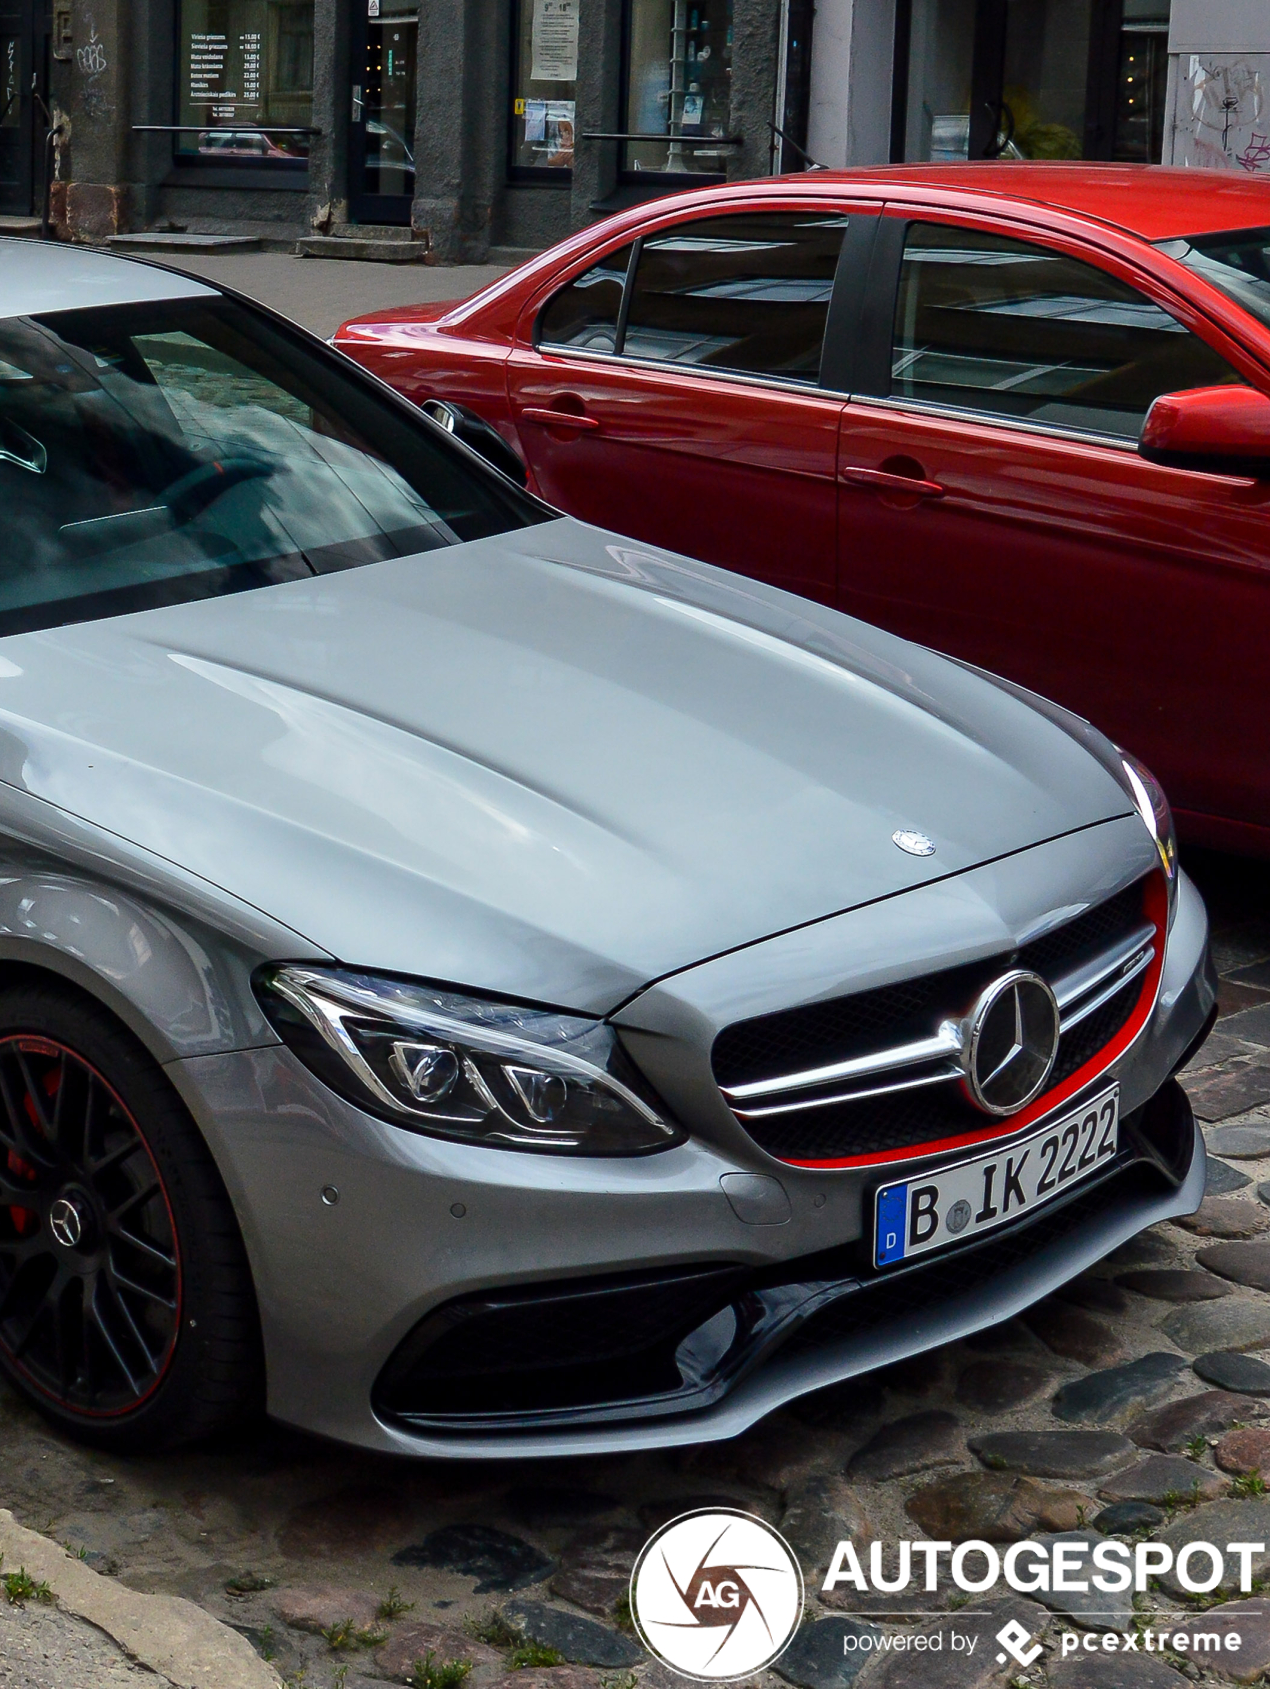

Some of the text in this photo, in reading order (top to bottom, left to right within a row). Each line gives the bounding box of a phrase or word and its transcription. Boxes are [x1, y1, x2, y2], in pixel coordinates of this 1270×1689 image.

[908, 1098, 1116, 1247] B IK 2222
[886, 1232, 897, 1249] D
